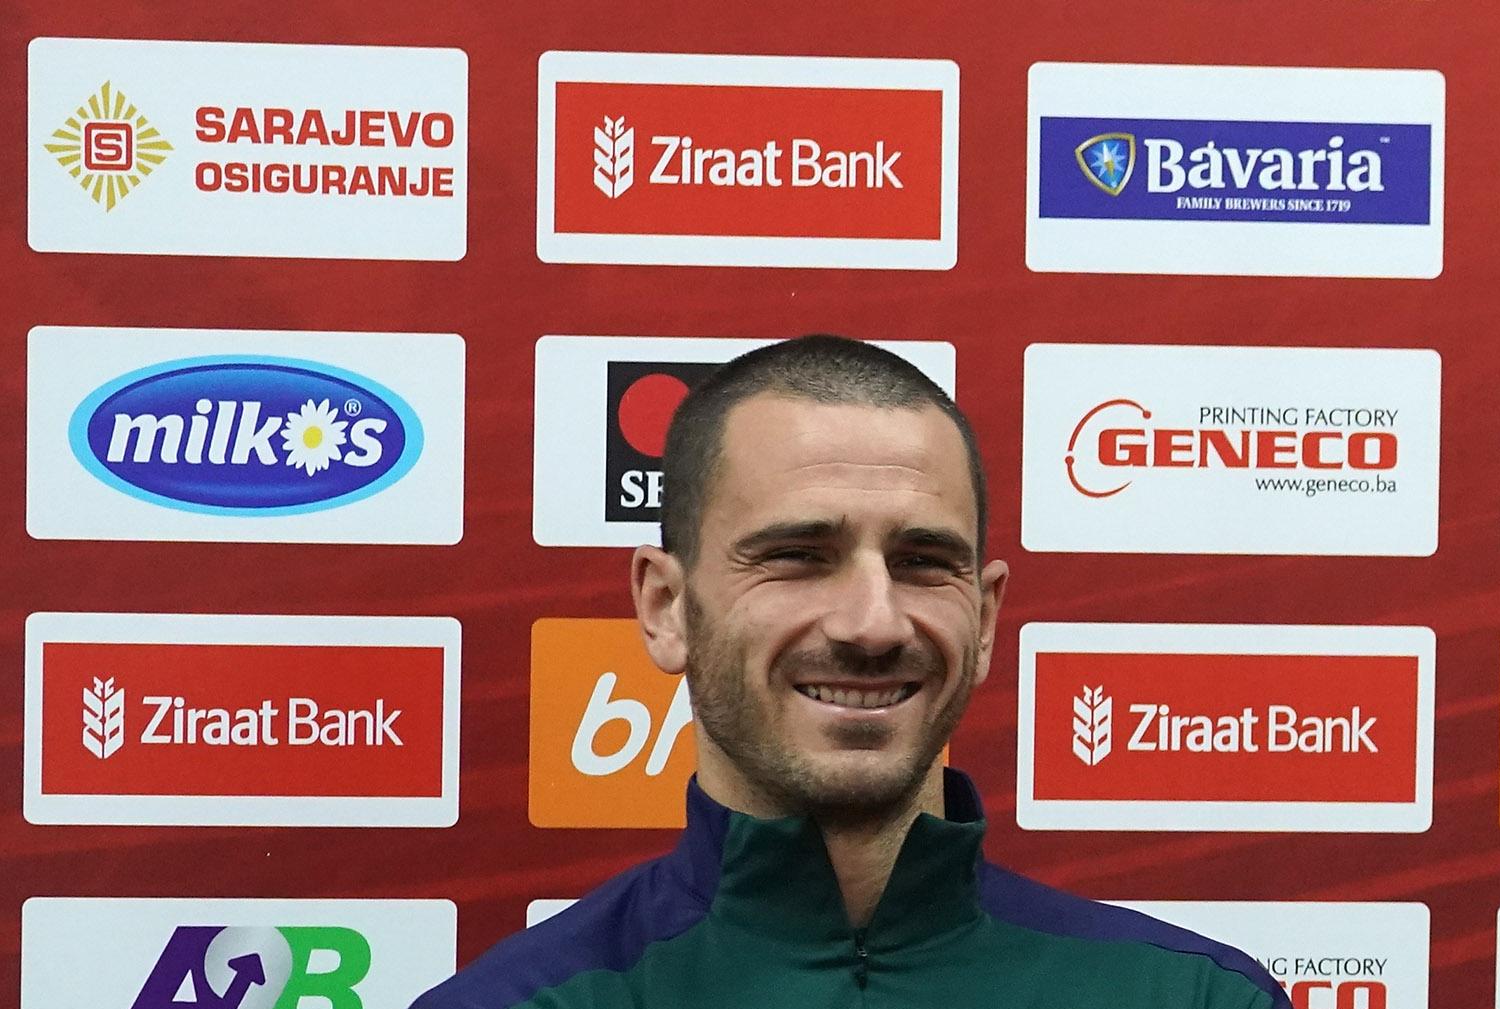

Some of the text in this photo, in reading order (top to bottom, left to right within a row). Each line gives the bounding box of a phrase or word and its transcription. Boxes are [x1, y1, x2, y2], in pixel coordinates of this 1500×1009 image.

[196, 107, 454, 148] SARAJEVO
[196, 162, 453, 197] OSIGURANJE
[650, 136, 903, 188] Ziraat Bank
[1144, 136, 1385, 193] Bavaria
[1177, 196, 1351, 212] FAMILY BREWERS SINCE 1719
[1200, 407, 1398, 426] PRINTING FACTORY
[1097, 428, 1398, 471] GENECO
[1255, 473, 1398, 497] www.geneco.ba
[141, 696, 403, 746] Ziraat Bank
[1128, 704, 1378, 753] Ziraat Bank
[1295, 957, 1387, 976] FACTORY
